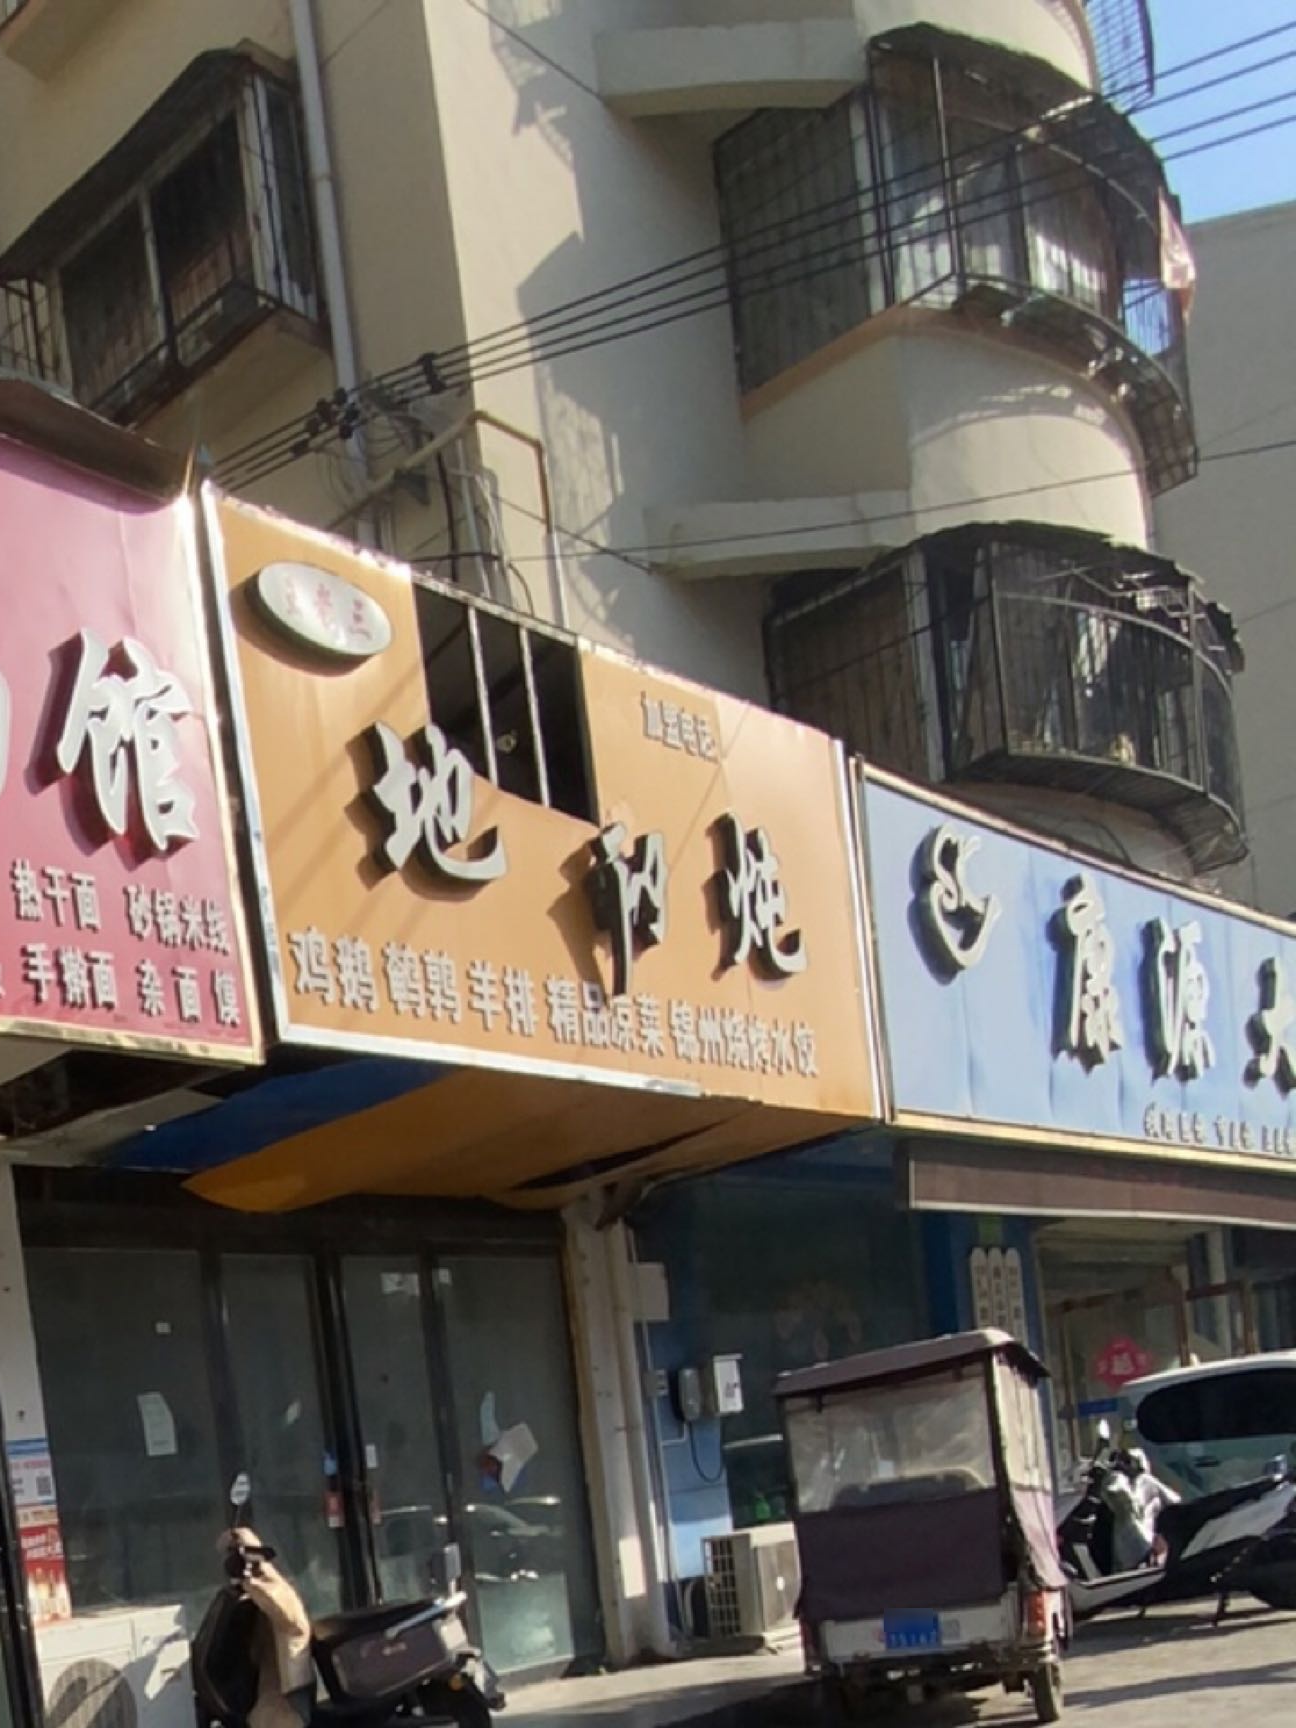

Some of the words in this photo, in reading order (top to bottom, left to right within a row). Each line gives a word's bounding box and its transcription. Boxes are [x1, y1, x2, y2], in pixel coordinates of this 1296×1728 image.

[10, 857, 102, 934] 热干面
[22, 941, 118, 1012] 手擀面
[286, 924, 381, 1014] 鸡鹅
[381, 940, 462, 1026] 鹌鹑
[466, 957, 540, 1038] 羊排
[544, 974, 666, 1060] 精品凉菜
